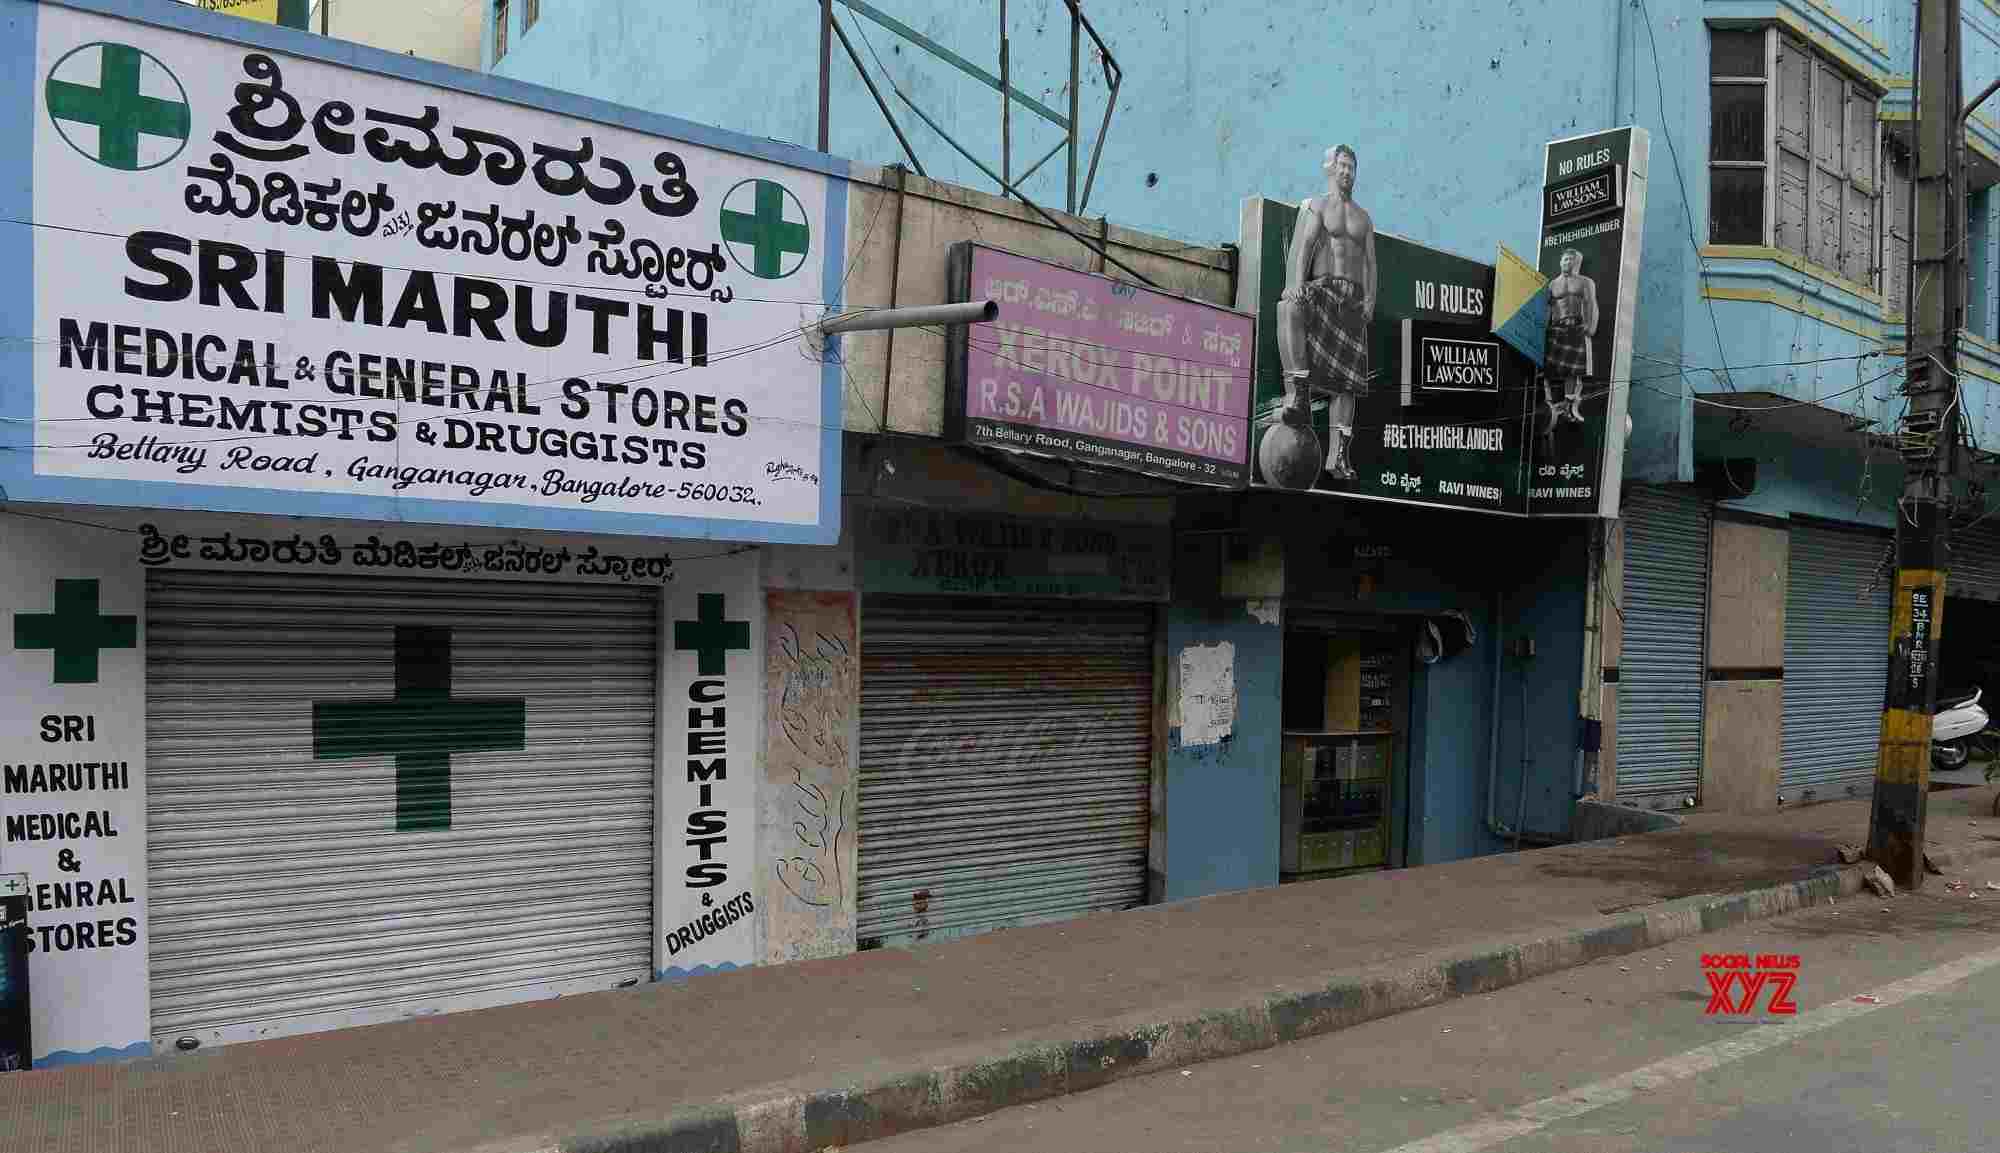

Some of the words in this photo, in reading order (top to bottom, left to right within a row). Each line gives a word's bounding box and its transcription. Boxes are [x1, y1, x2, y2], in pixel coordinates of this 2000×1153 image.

[1559, 159, 1573, 176] NO
[1576, 148, 1611, 172] RULES
[1555, 180, 1600, 201] WILLIAM
[184, 152, 395, 237] ಮೆಡಿಕಲ್
[416, 200, 582, 267] ಜನರಲ್
[588, 218, 734, 303] ಸ್ಟೋರ್ಸ್
[124, 230, 285, 314] SRI
[311, 255, 708, 368] MARUTHI
[1415, 280, 1435, 311] NO
[1440, 284, 1484, 316] RULES
[992, 320, 1120, 390] XEROX
[1132, 354, 1234, 413] POINT
[1429, 345, 1489, 366] WILLIAM
[59, 317, 289, 389] MEDICAL
[294, 355, 316, 382] &
[324, 350, 541, 416] GENERAL
[560, 376, 749, 438] STORES
[1426, 366, 1493, 385] LAWSON'S
[86, 384, 398, 442] CHEMISTS
[416, 421, 437, 446] &
[443, 418, 707, 470] DRUGGISTS
[979, 377, 1048, 420] R.S.A
[1055, 387, 1149, 439] WAJIDS
[1154, 411, 1170, 445] &
[1176, 415, 1237, 456] SONS
[88, 431, 206, 474] Bellary
[975, 424, 994, 438] 7th
[995, 427, 1033, 445] Bellary
[1145, 451, 1196, 473] Bangalore
[1204, 464, 1217, 475] 32
[1384, 423, 1503, 451] #BETHEHIGHLANDER
[1439, 480, 1464, 495] RAVI
[1466, 484, 1500, 500] WINES
[1556, 487, 1592, 498] WINES
[352, 536, 472, 570] ಮೆಡಿಕಲ್
[40, 714, 96, 743] SRI
[3, 762, 129, 793] MARUTHI
[685, 680, 728, 889] CHEMISTS
[6, 811, 118, 842] MEDICAL
[57, 848, 82, 873] &
[701, 892, 715, 908] &
[665, 891, 756, 956] DRUGGISTS
